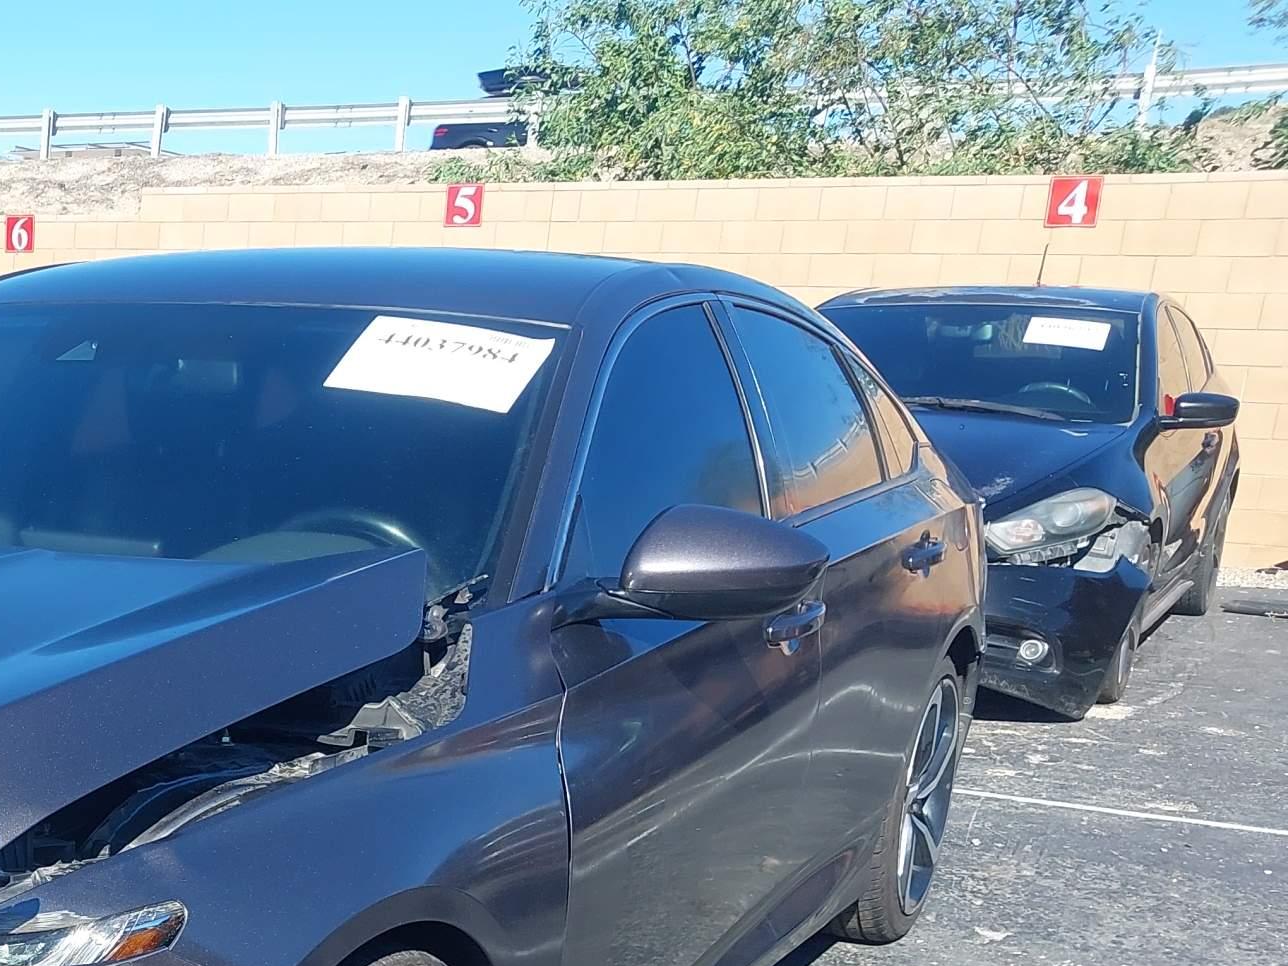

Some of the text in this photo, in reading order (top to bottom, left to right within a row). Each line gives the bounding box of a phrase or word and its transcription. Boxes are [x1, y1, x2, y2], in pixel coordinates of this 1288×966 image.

[452, 186, 477, 224] 5
[1057, 179, 1089, 224] 4
[11, 217, 29, 250] 6
[377, 332, 519, 363] 44037984
